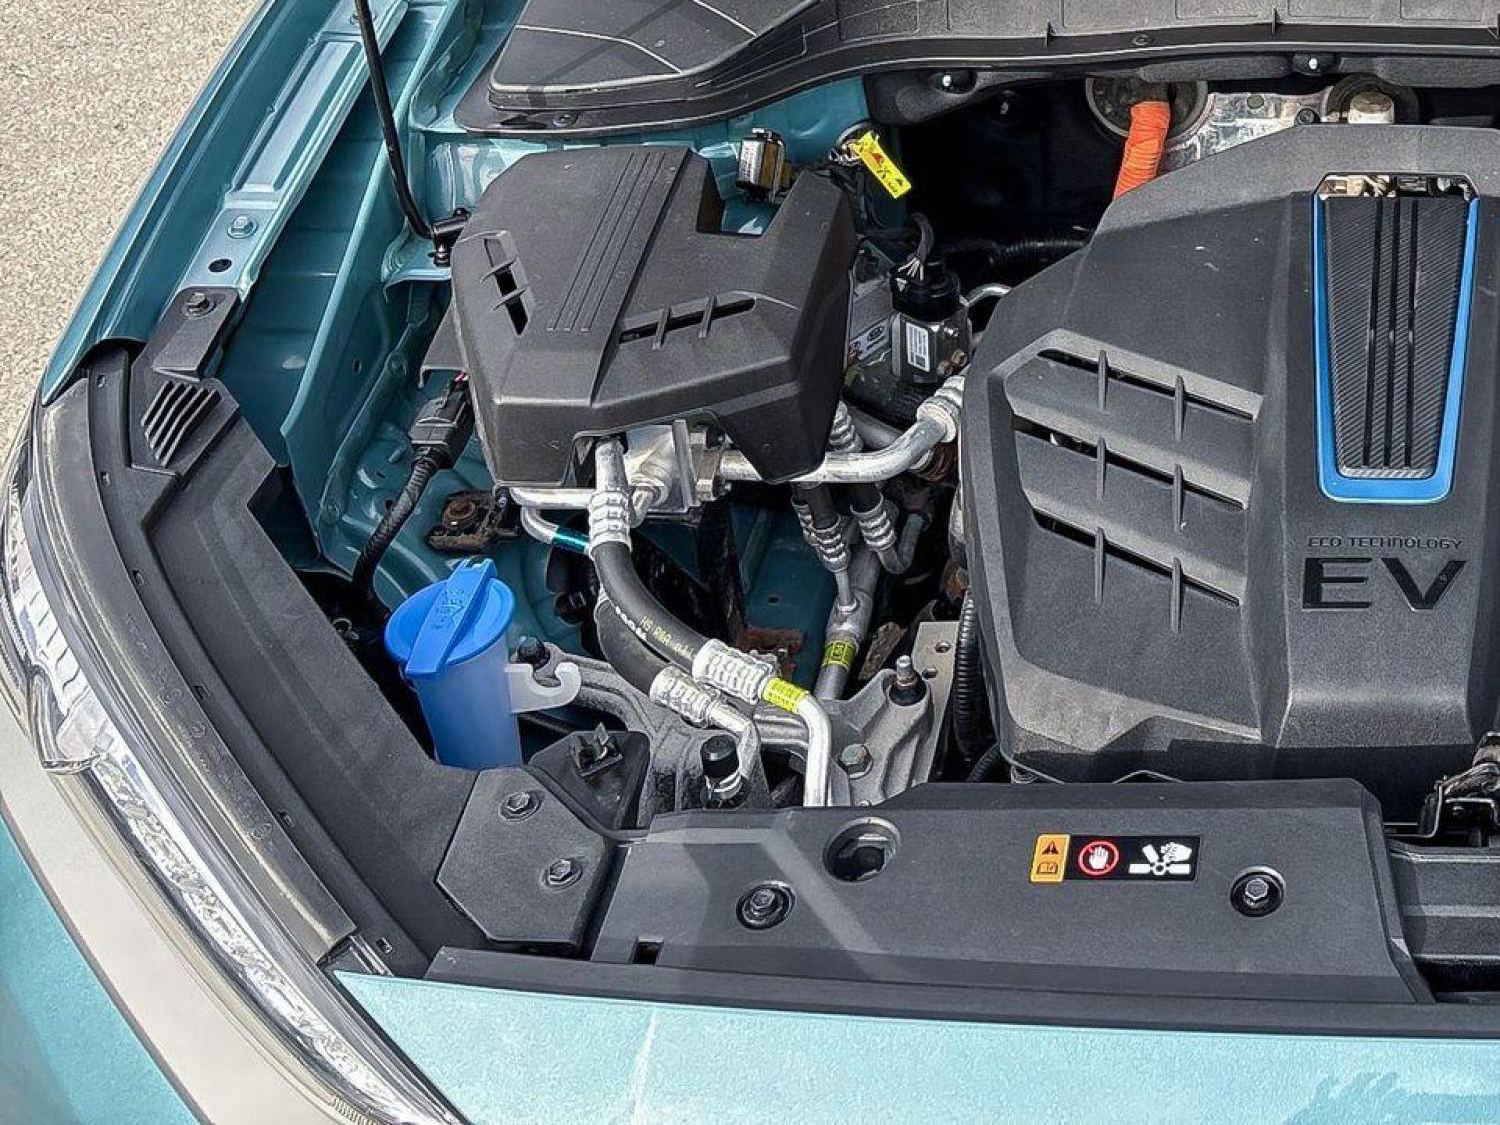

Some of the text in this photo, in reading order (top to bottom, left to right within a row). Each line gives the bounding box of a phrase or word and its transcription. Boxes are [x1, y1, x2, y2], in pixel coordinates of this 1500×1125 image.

[1308, 537, 1464, 549] ECO TECHNOLOGY
[1302, 557, 1467, 611] EV
